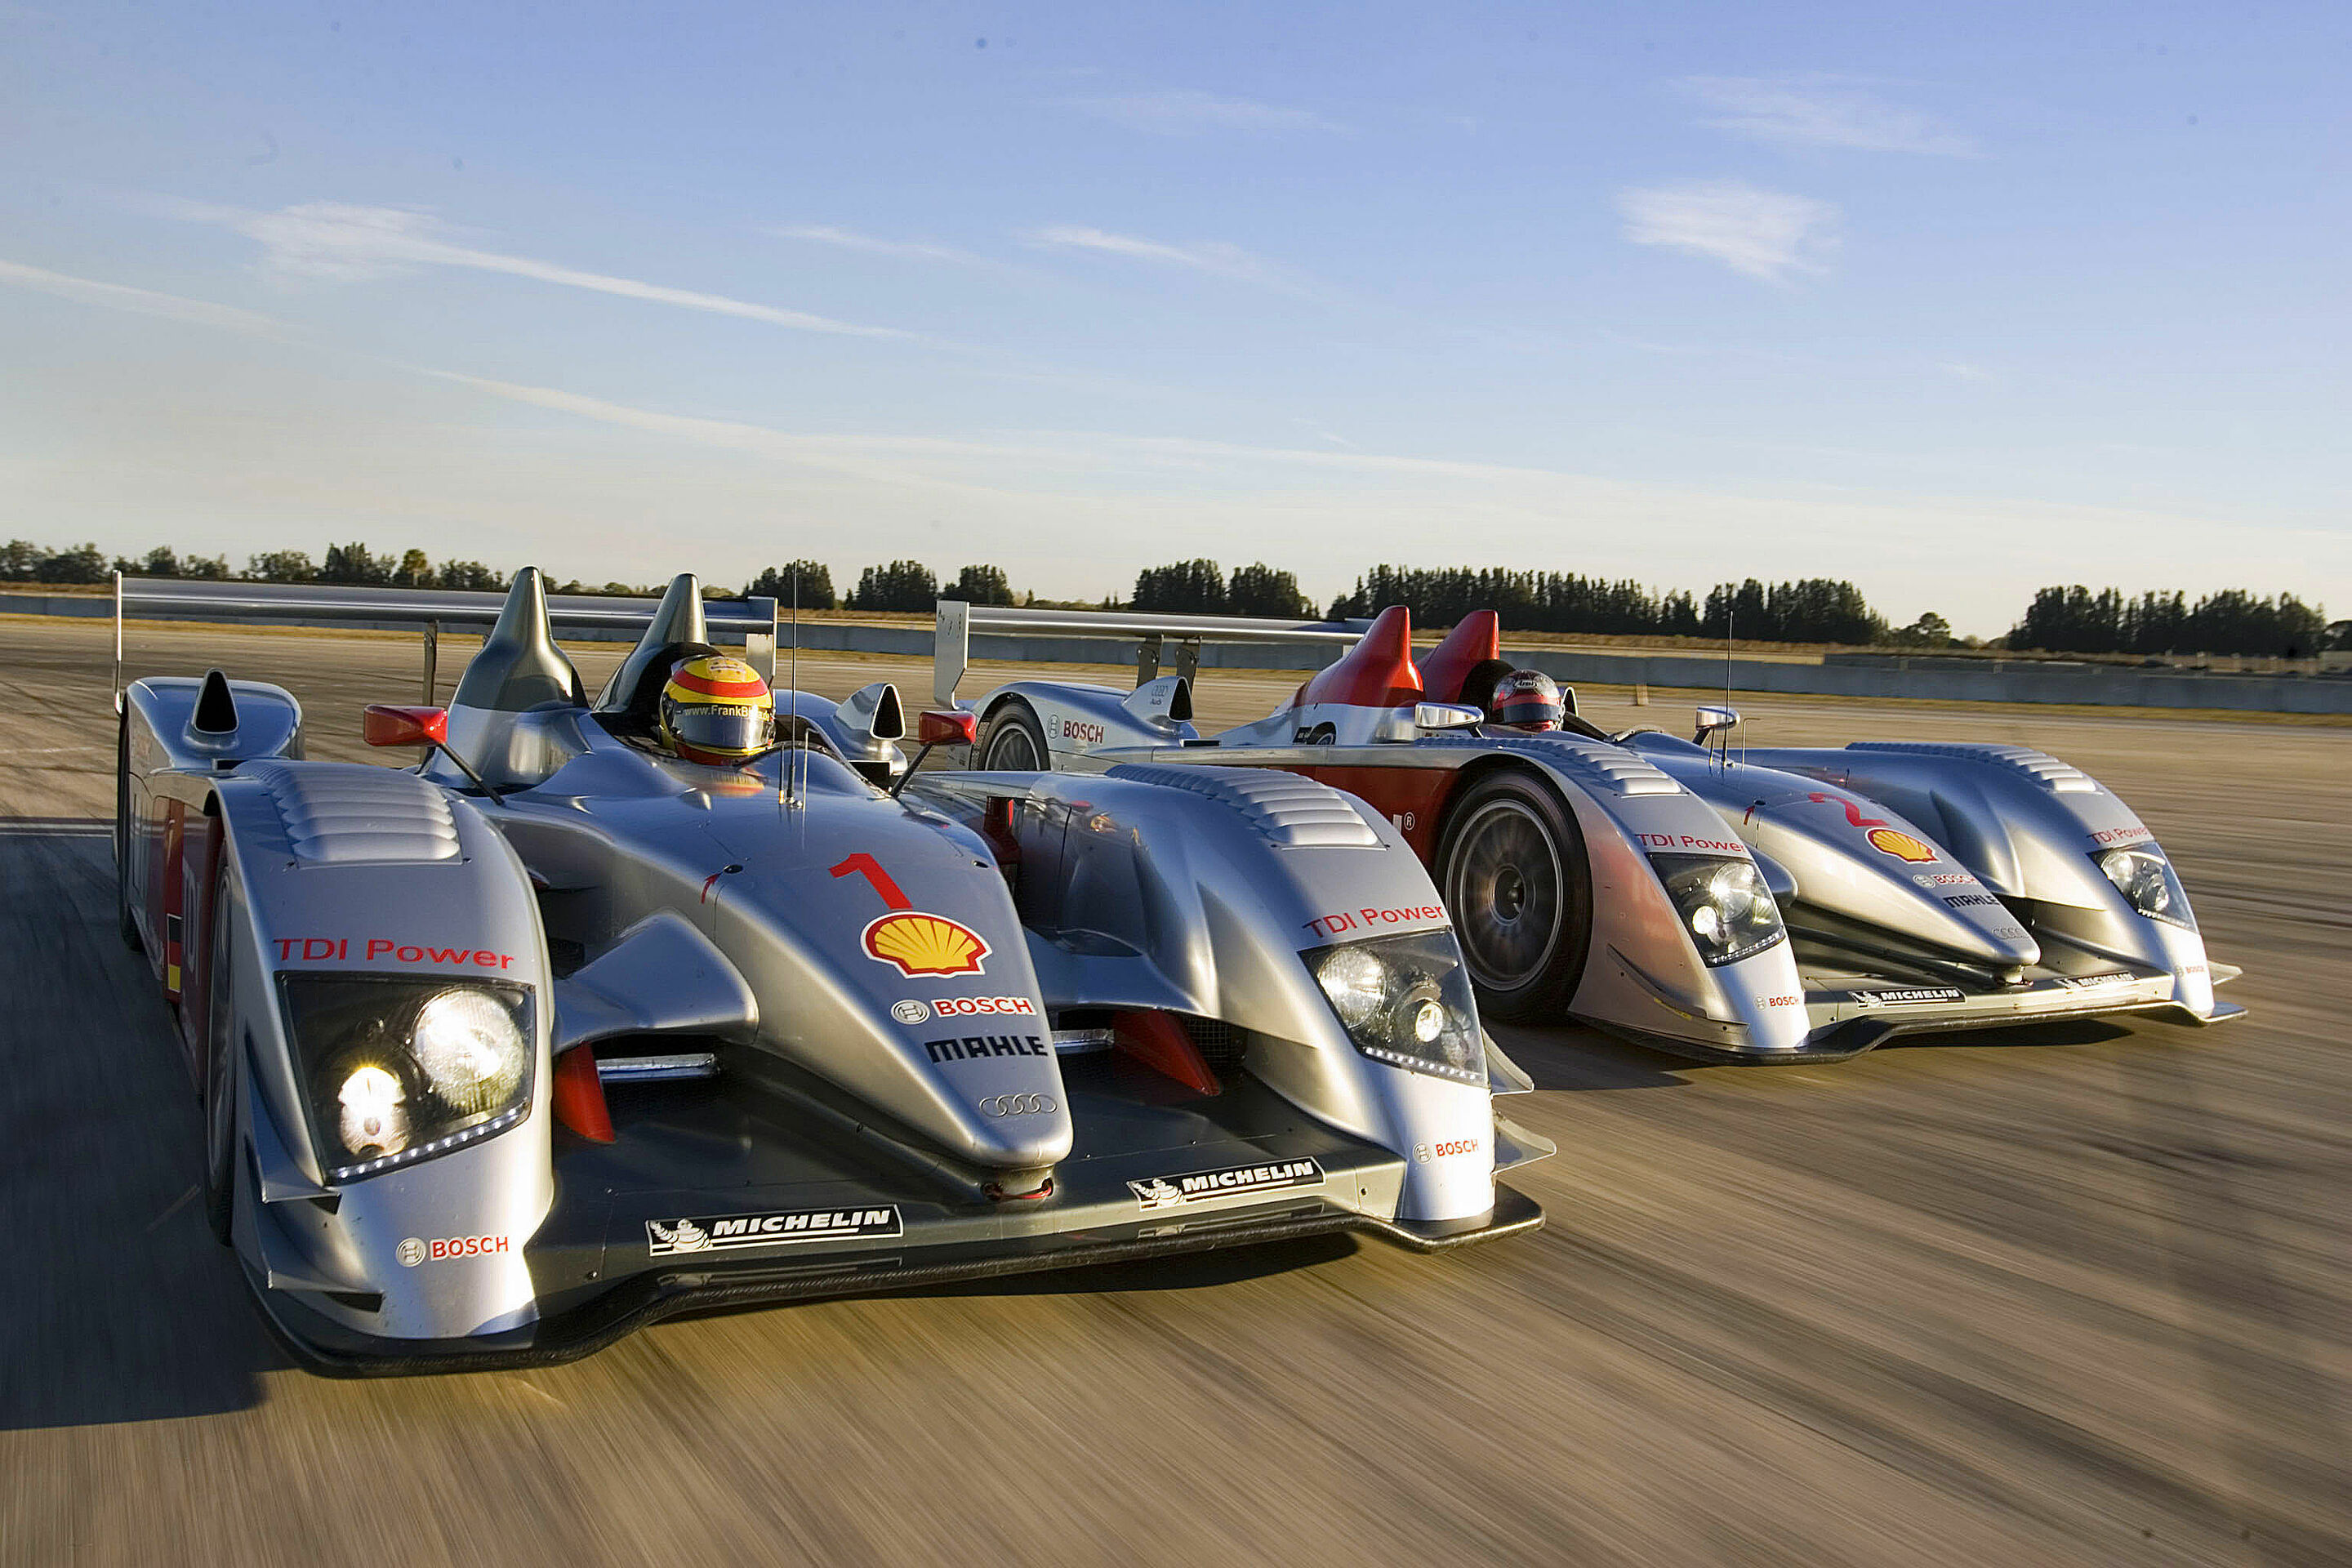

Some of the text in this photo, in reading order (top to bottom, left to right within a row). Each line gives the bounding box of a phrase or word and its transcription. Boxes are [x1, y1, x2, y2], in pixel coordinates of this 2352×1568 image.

[1063, 719, 1104, 744] BOSCH
[1807, 792, 1892, 827] 2
[1634, 833, 1746, 853] TDI Power
[2086, 830, 2117, 844] TDI
[828, 853, 914, 910] 1
[1943, 895, 2000, 908] MAHLE
[1302, 906, 1445, 938] TDI Power
[274, 938, 515, 969] TDI Power
[1768, 996, 1800, 1007] BOSCH
[1881, 989, 1959, 1001] MICHELIN
[933, 997, 1036, 1017] BOSCH
[924, 1036, 1049, 1063] MAHLE
[1435, 1138, 1480, 1157] BOSCH
[1183, 1161, 1314, 1192] MICHELIN
[711, 1209, 891, 1236] MICHELIN
[431, 1236, 509, 1258] BOSCH
